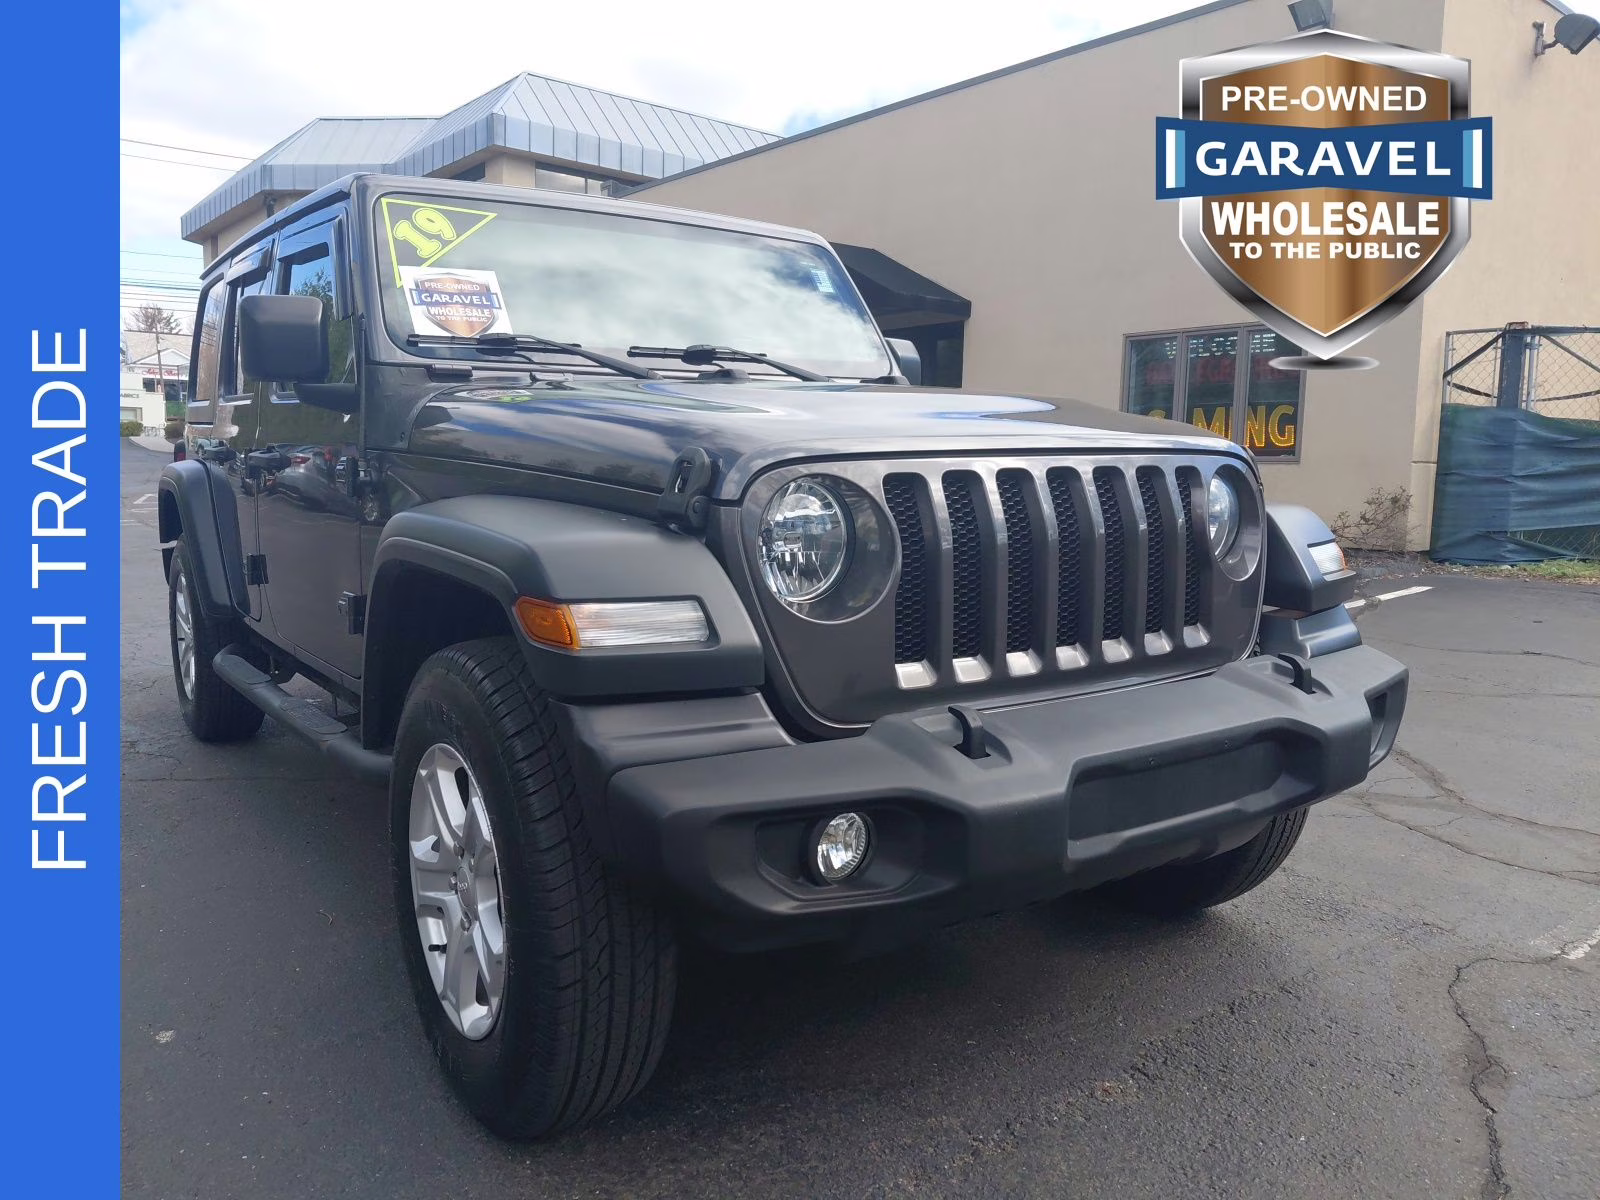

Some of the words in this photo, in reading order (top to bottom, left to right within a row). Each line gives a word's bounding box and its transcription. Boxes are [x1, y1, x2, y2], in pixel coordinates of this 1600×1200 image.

[393, 207, 457, 258] 19
[424, 281, 480, 291] PRE-OWNED
[421, 293, 491, 305] GARAVEL
[428, 306, 492, 317] WHOLESALE
